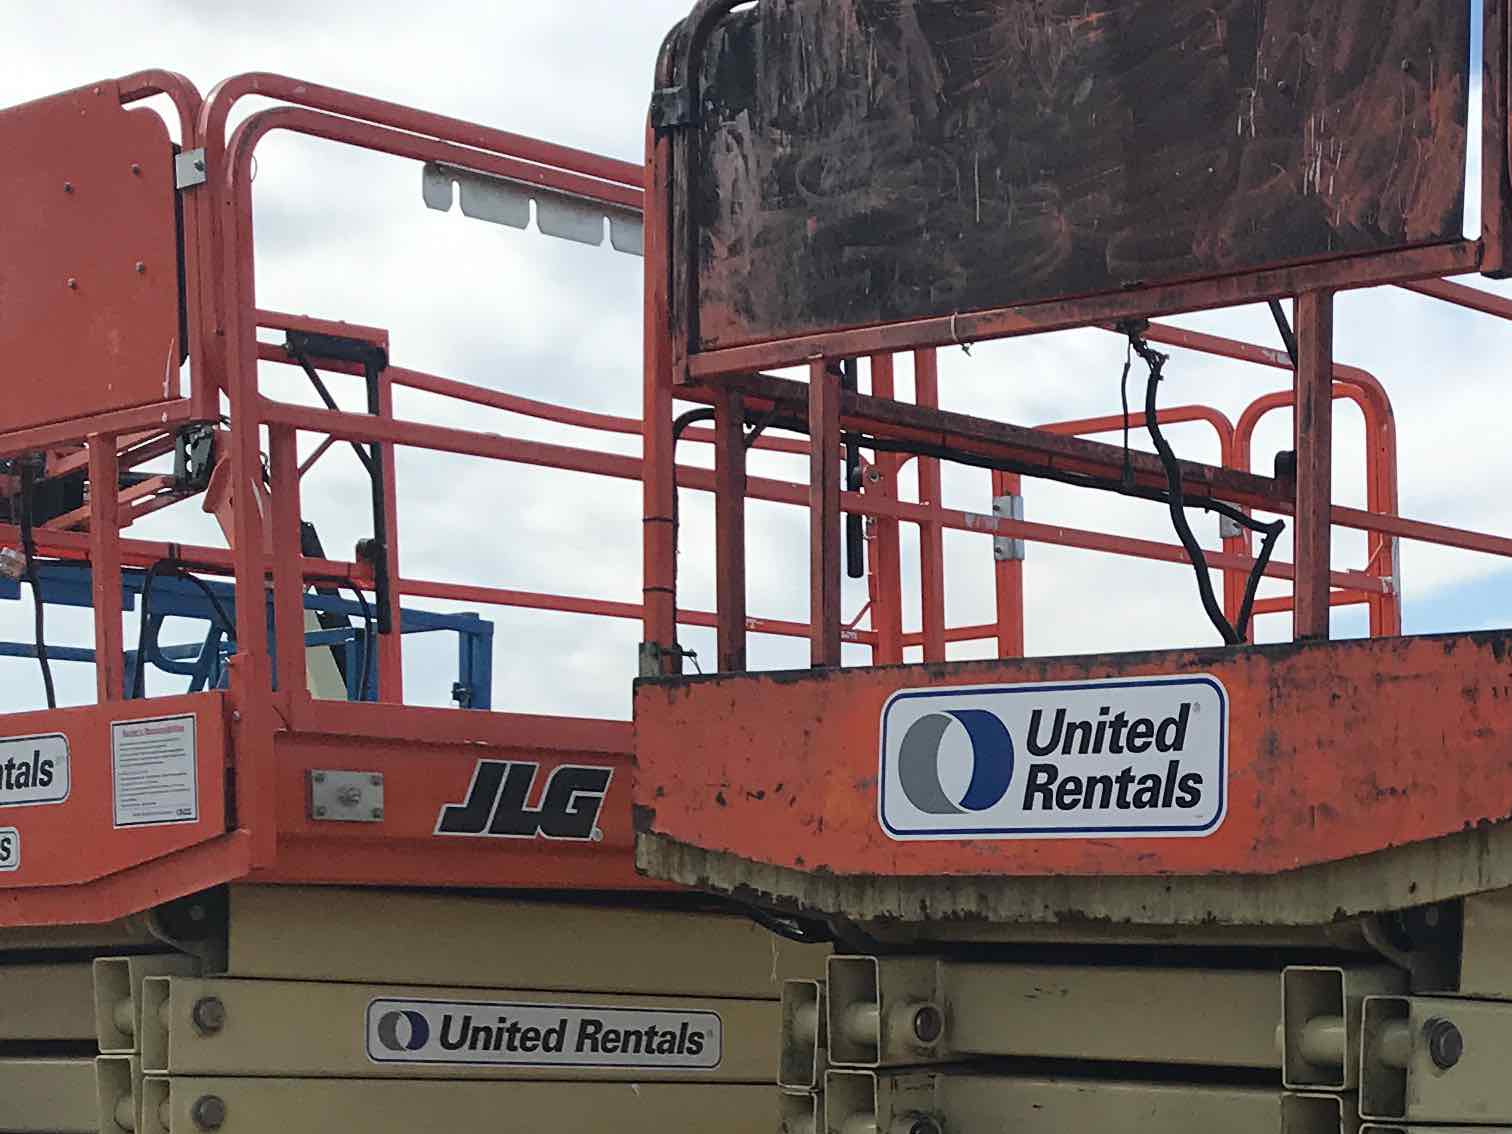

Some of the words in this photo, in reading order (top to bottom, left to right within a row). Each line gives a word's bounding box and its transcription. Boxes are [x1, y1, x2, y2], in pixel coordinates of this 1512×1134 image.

[1027, 703, 1191, 756] United
[0, 750, 54, 790] tals
[1022, 760, 1203, 810] Rentals
[434, 759, 614, 841] JLG
[440, 1014, 568, 1053] United
[575, 1019, 705, 1055] Rentals
